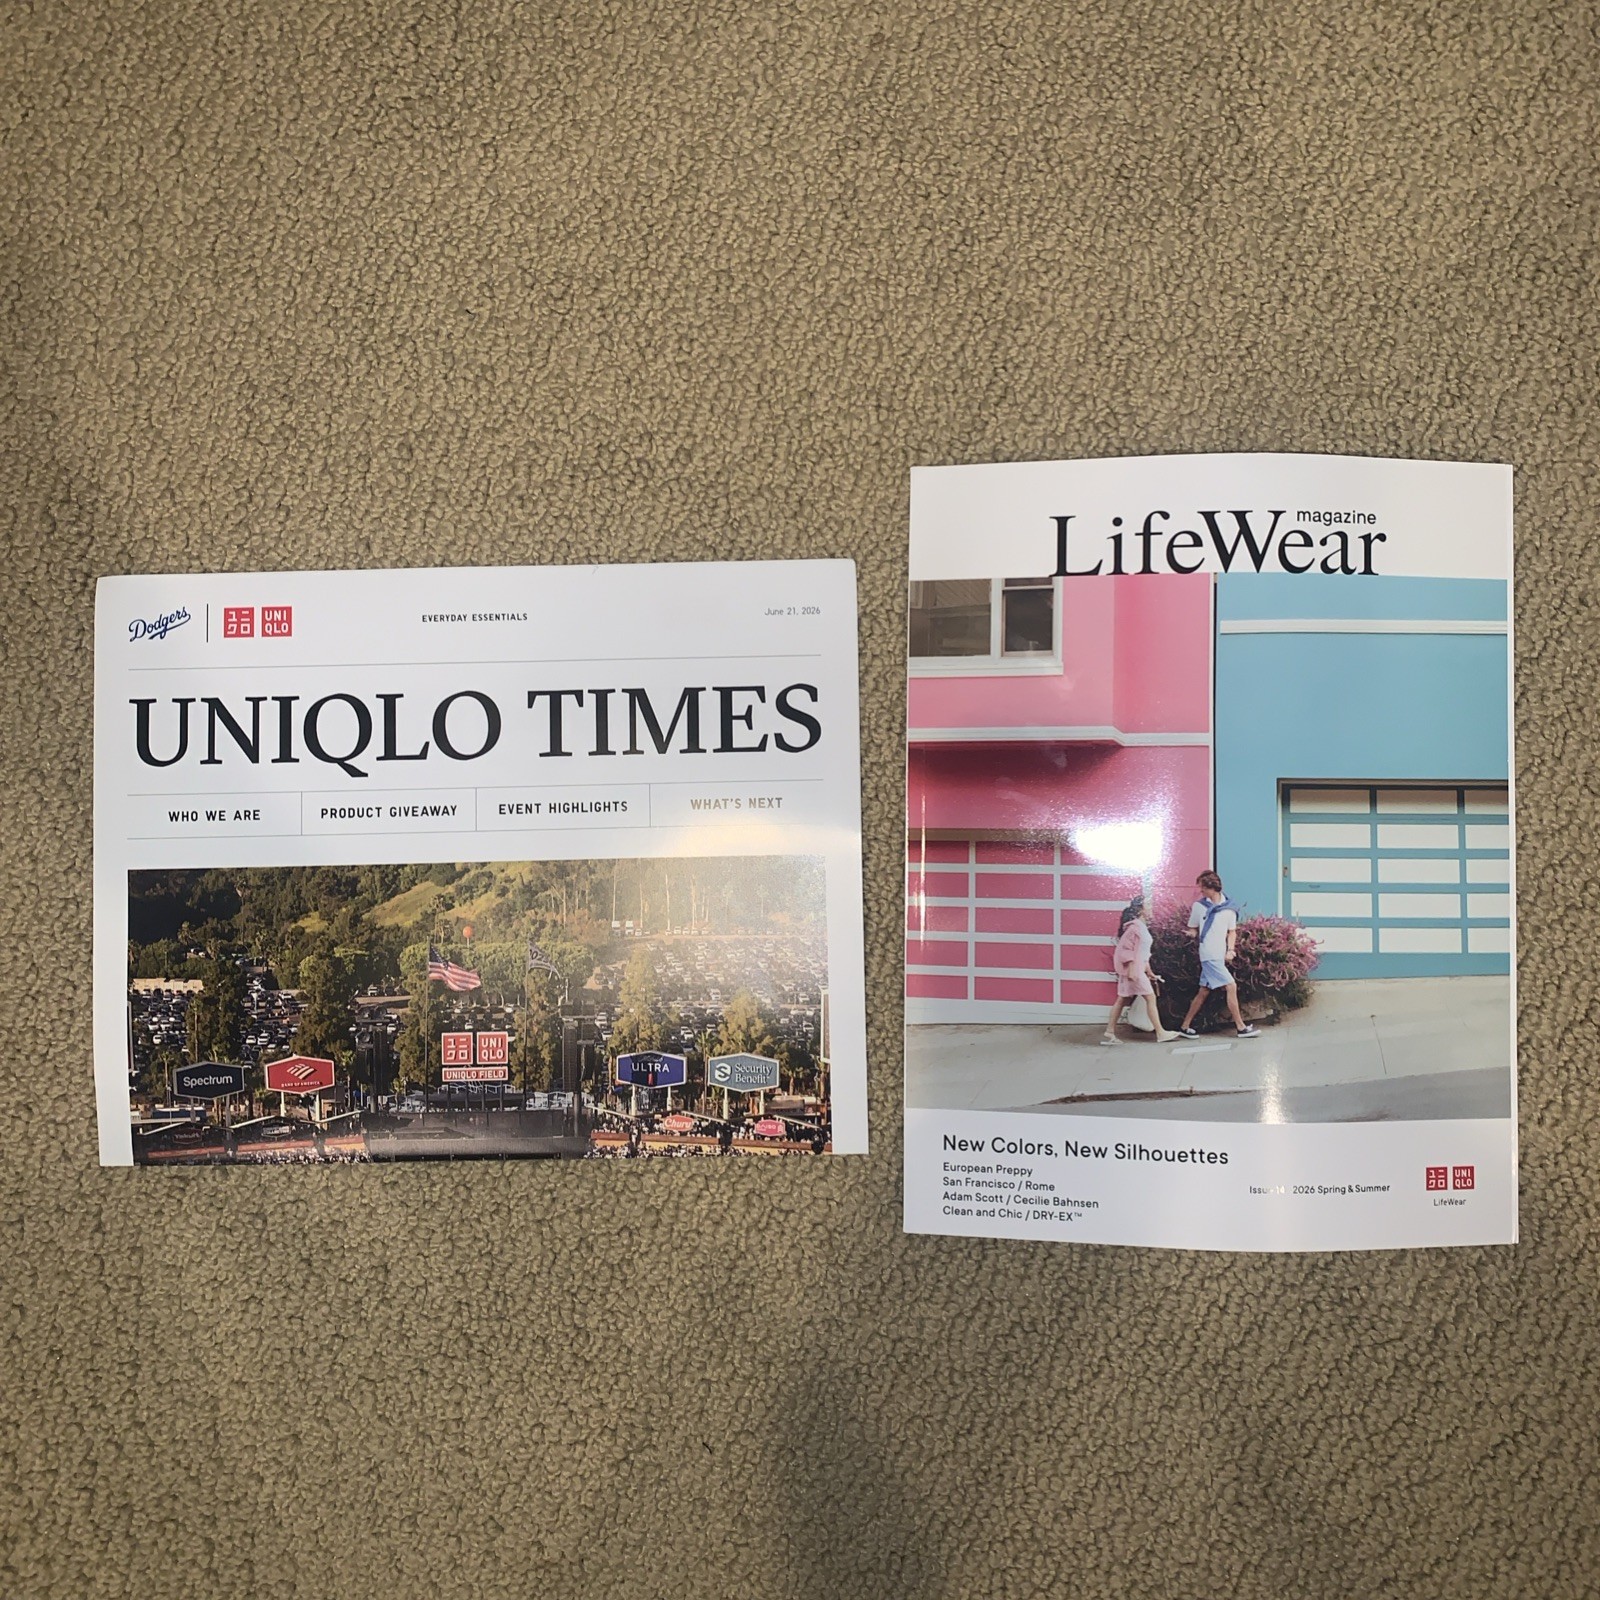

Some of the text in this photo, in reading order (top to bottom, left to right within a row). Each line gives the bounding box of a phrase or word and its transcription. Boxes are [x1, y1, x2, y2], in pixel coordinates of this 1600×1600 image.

[1296, 509, 1377, 527] magazine
[1048, 509, 1388, 578] LifeWear
[264, 609, 287, 622] UNI
[421, 612, 528, 623] EVERYDAY ESSENTIALS
[764, 606, 821, 616] June 21, 2026
[128, 606, 192, 643] Dodgers
[264, 622, 289, 636] QLO
[128, 682, 822, 778] UNIQLO TIMES
[498, 800, 628, 815] EVENT HIGHLIGHTS
[748, 796, 783, 809] NEXT
[168, 809, 261, 823] WHO WE ARE
[320, 804, 457, 819] PRODUCT GIVEAWAY
[481, 1037, 502, 1049] UNI
[481, 1049, 504, 1061] QLO
[446, 1069, 505, 1080] UNIQLO FIELD
[631, 1062, 670, 1073] ULTRA
[735, 1063, 773, 1076] Security
[183, 1075, 233, 1089] Spectrum
[943, 1134, 1229, 1165] New Colors, New Silhouettes
[942, 1161, 1033, 1178] European Preppy
[1454, 1169, 1471, 1178] UNI
[942, 1176, 1056, 1192] San Francisco / Rome
[1249, 1185, 1271, 1194] Issu
[1292, 1185, 1316, 1195] 2026
[1317, 1185, 1347, 1196] Spring
[1347, 1184, 1354, 1194] &
[1354, 1184, 1391, 1193] Summer
[1454, 1178, 1472, 1188] QLO
[942, 1191, 1099, 1209] Adam Scott / Cecilie Bahnsen
[1433, 1198, 1467, 1207] LifeWear
[942, 1205, 974, 1216] Clean
[975, 1208, 996, 1218] and
[997, 1208, 1023, 1219] Chic
[1024, 1209, 1031, 1222] /
